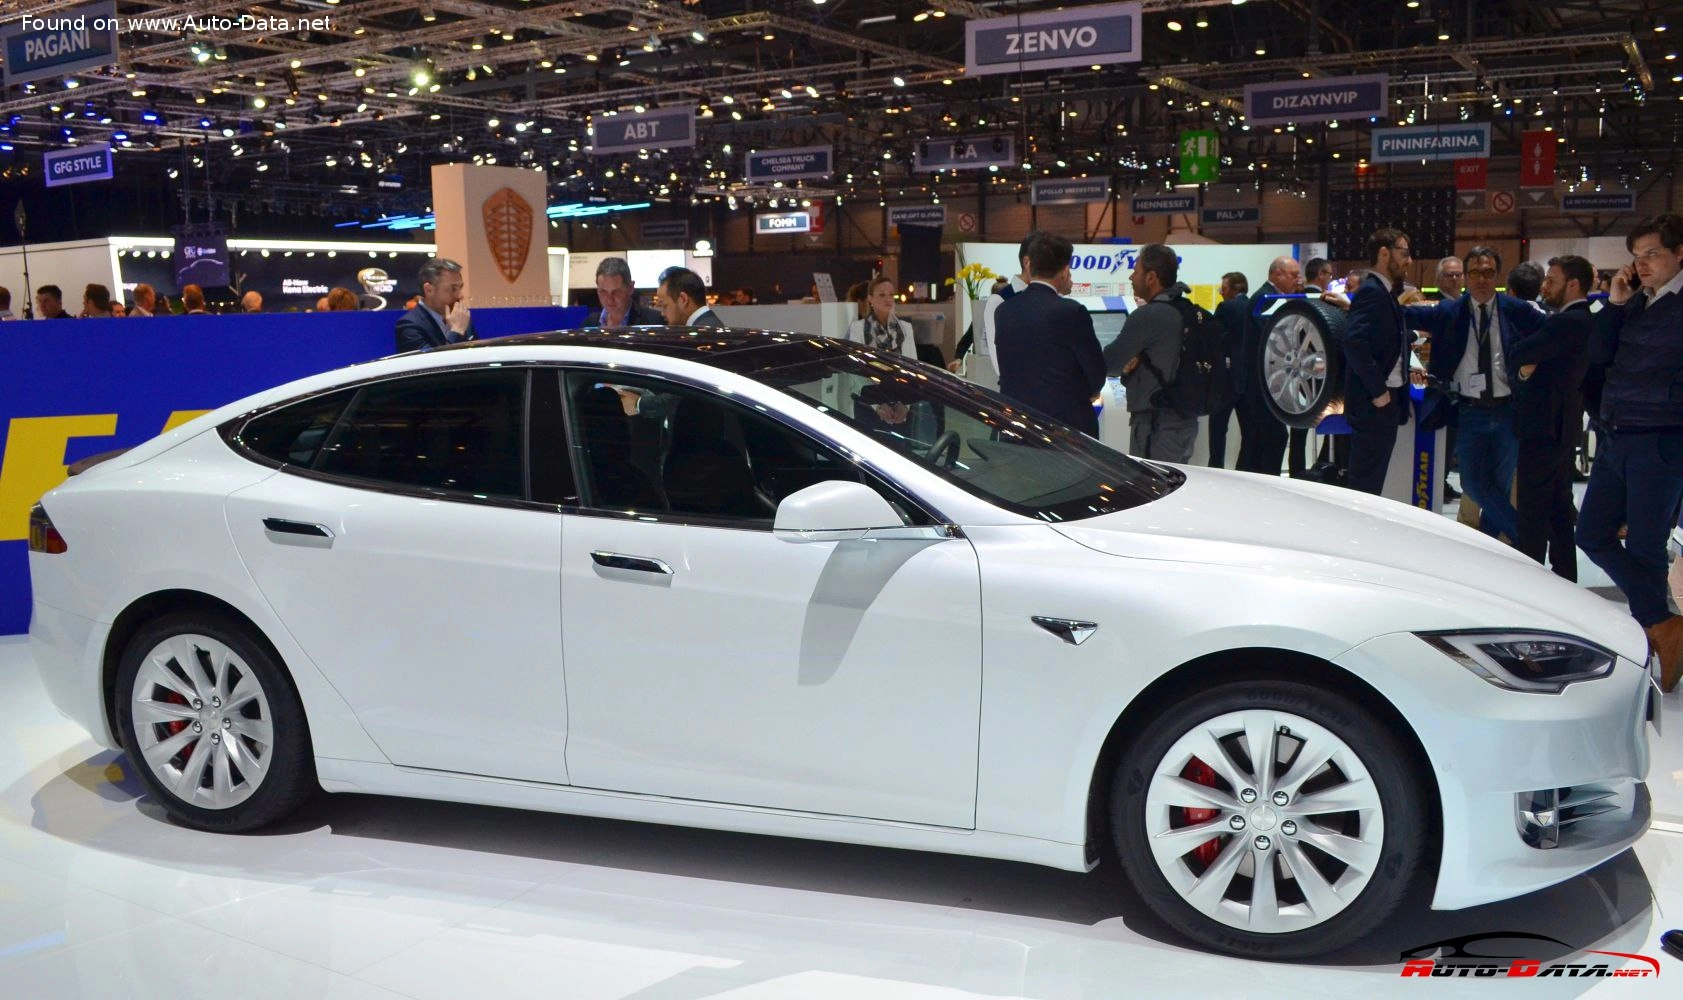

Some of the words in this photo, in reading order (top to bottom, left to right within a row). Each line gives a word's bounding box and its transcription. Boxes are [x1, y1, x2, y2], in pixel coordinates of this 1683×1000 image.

[24, 28, 91, 62] PAGANI
[1005, 25, 1098, 55] ZENVO
[1272, 91, 1358, 109] DIZAYNVIP
[623, 121, 660, 141] ABT
[1381, 135, 1479, 151] PININFARINA
[53, 160, 73, 174] GFG
[73, 156, 102, 171] STYLE
[761, 156, 792, 166] CHELSEA
[792, 154, 815, 163] TRUCK
[771, 163, 806, 173] COMPANY
[1459, 164, 1481, 174] EXIT
[1135, 199, 1191, 210] HENNESSEY
[1216, 210, 1245, 220] PAL-V
[768, 218, 797, 228] FOMM
